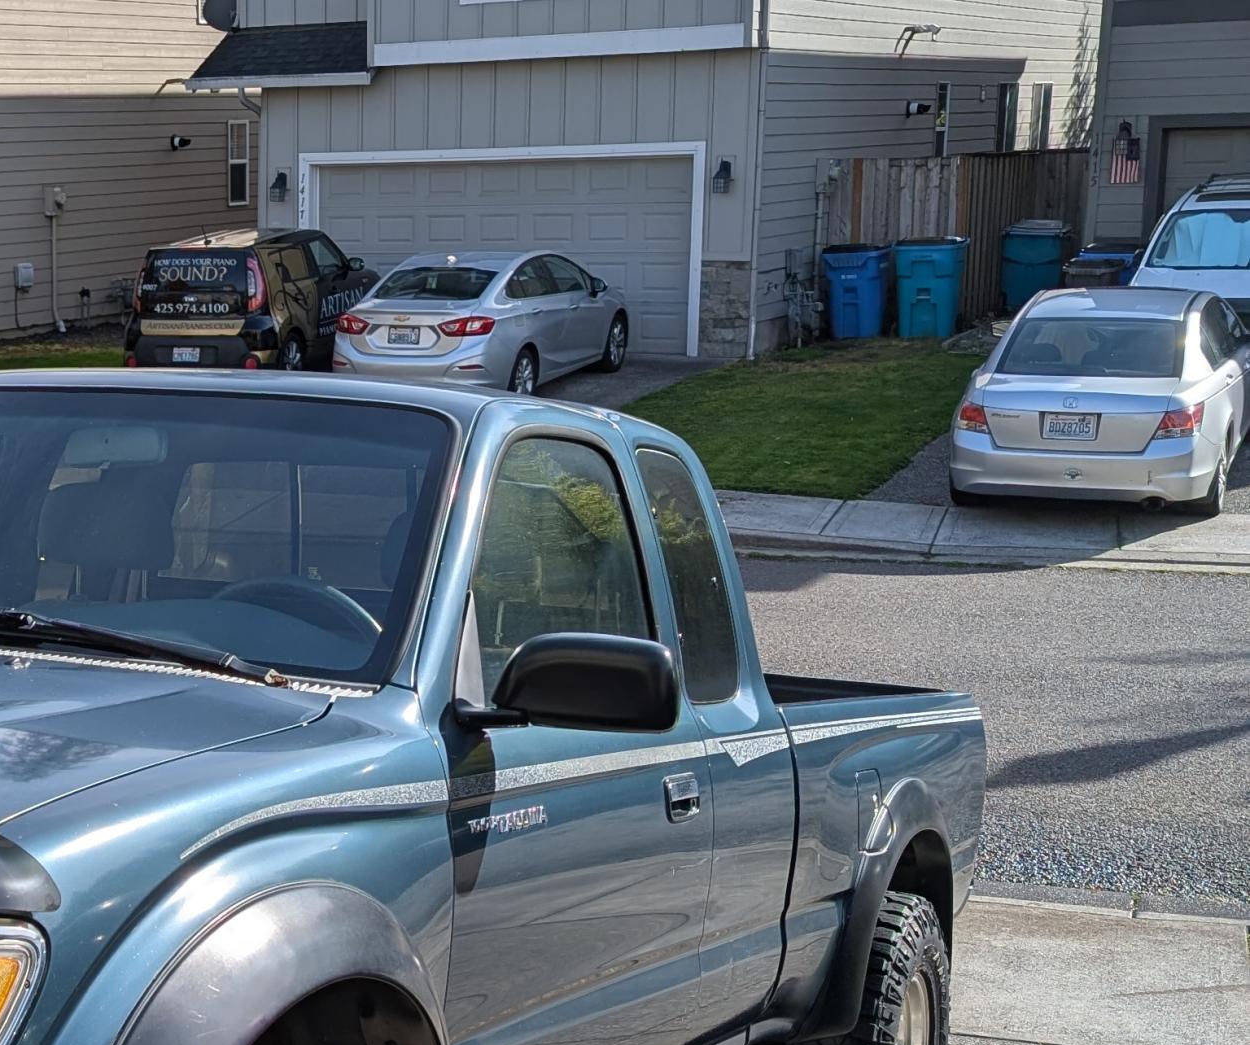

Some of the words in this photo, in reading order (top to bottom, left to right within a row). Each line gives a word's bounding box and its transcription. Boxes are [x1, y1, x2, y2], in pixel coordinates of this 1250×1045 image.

[171, 259, 190, 267] DOES
[191, 258, 212, 266] YOUR
[158, 266, 227, 282] SOUND?
[153, 303, 229, 314] 425.974.4100
[320, 286, 364, 319] ARTISAN
